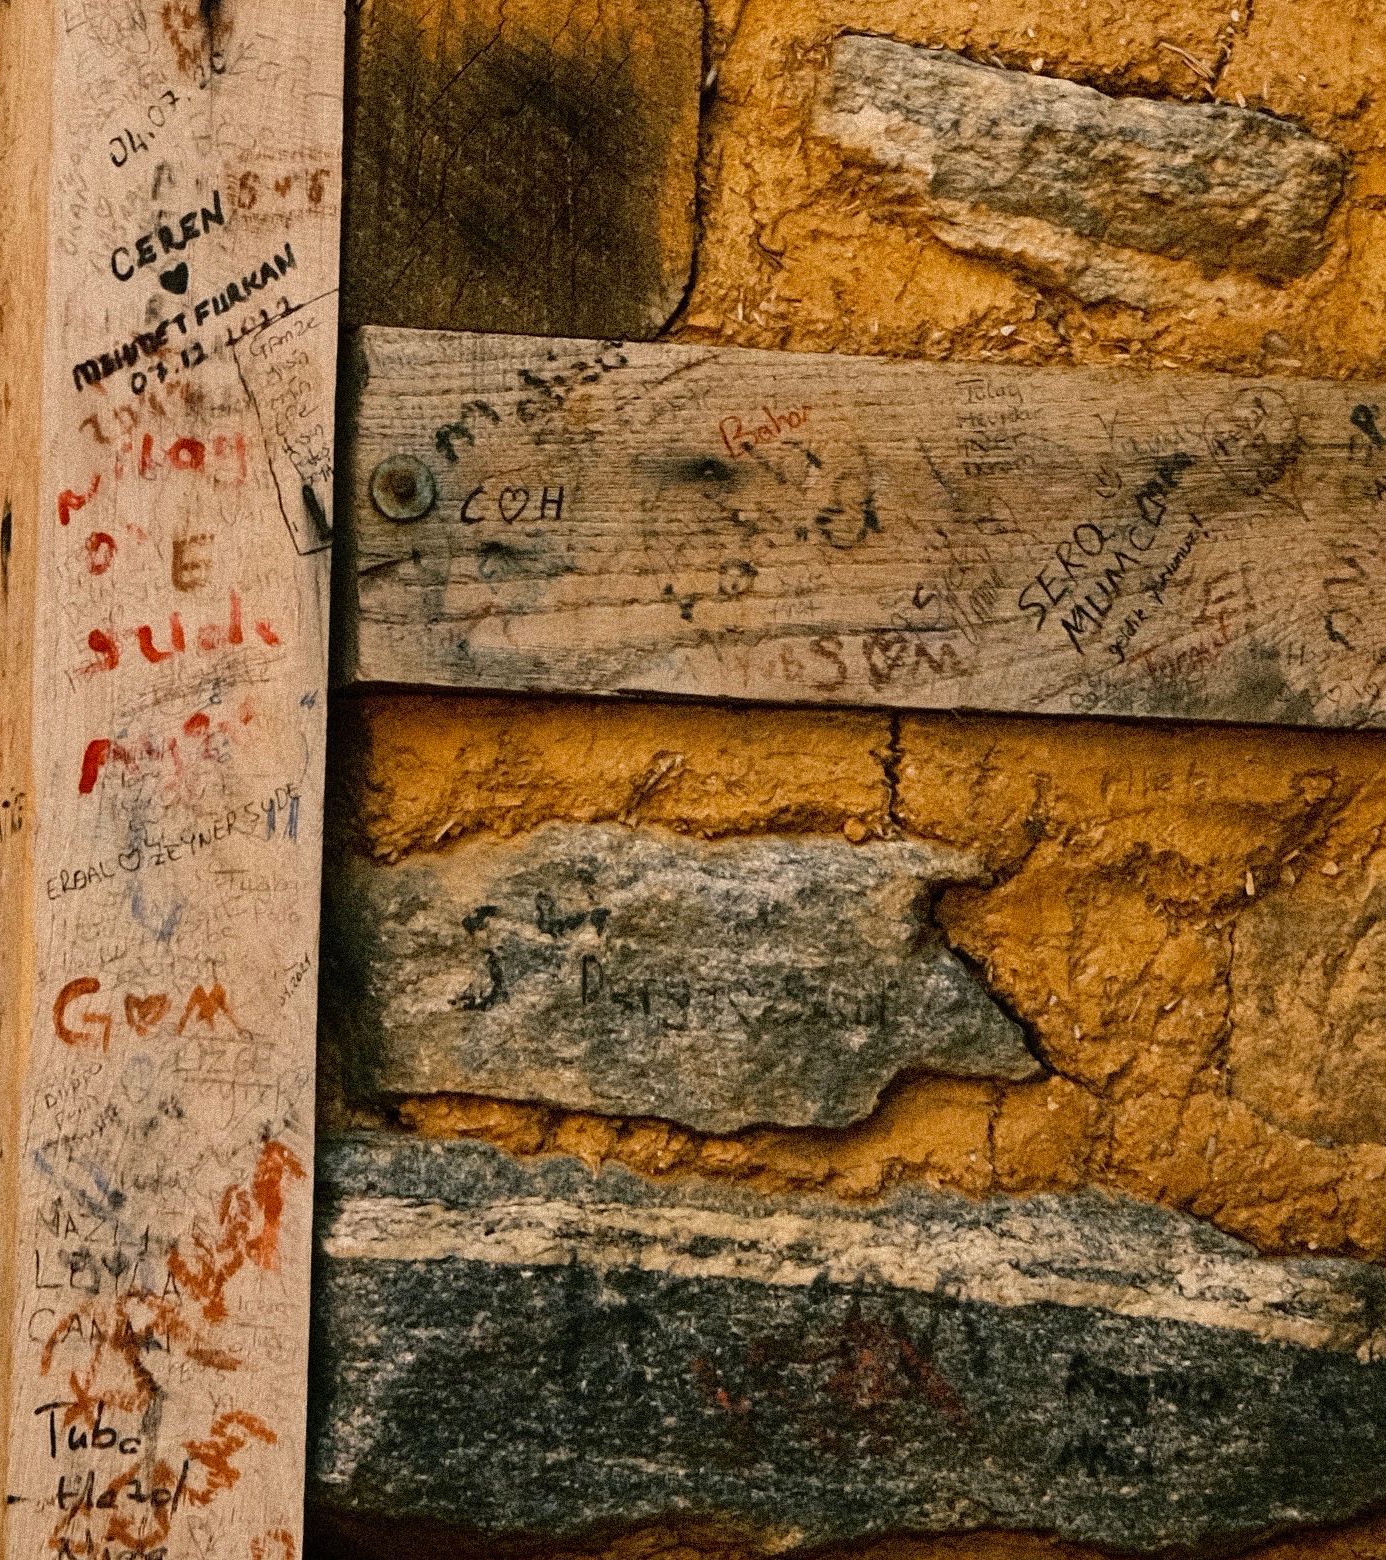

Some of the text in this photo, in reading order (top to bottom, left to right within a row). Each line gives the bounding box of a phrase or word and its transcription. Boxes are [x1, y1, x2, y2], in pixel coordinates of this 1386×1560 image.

[111, 189, 226, 282] CEREN
[194, 242, 297, 327] FURKAN
[1019, 522, 1113, 632] SERO
